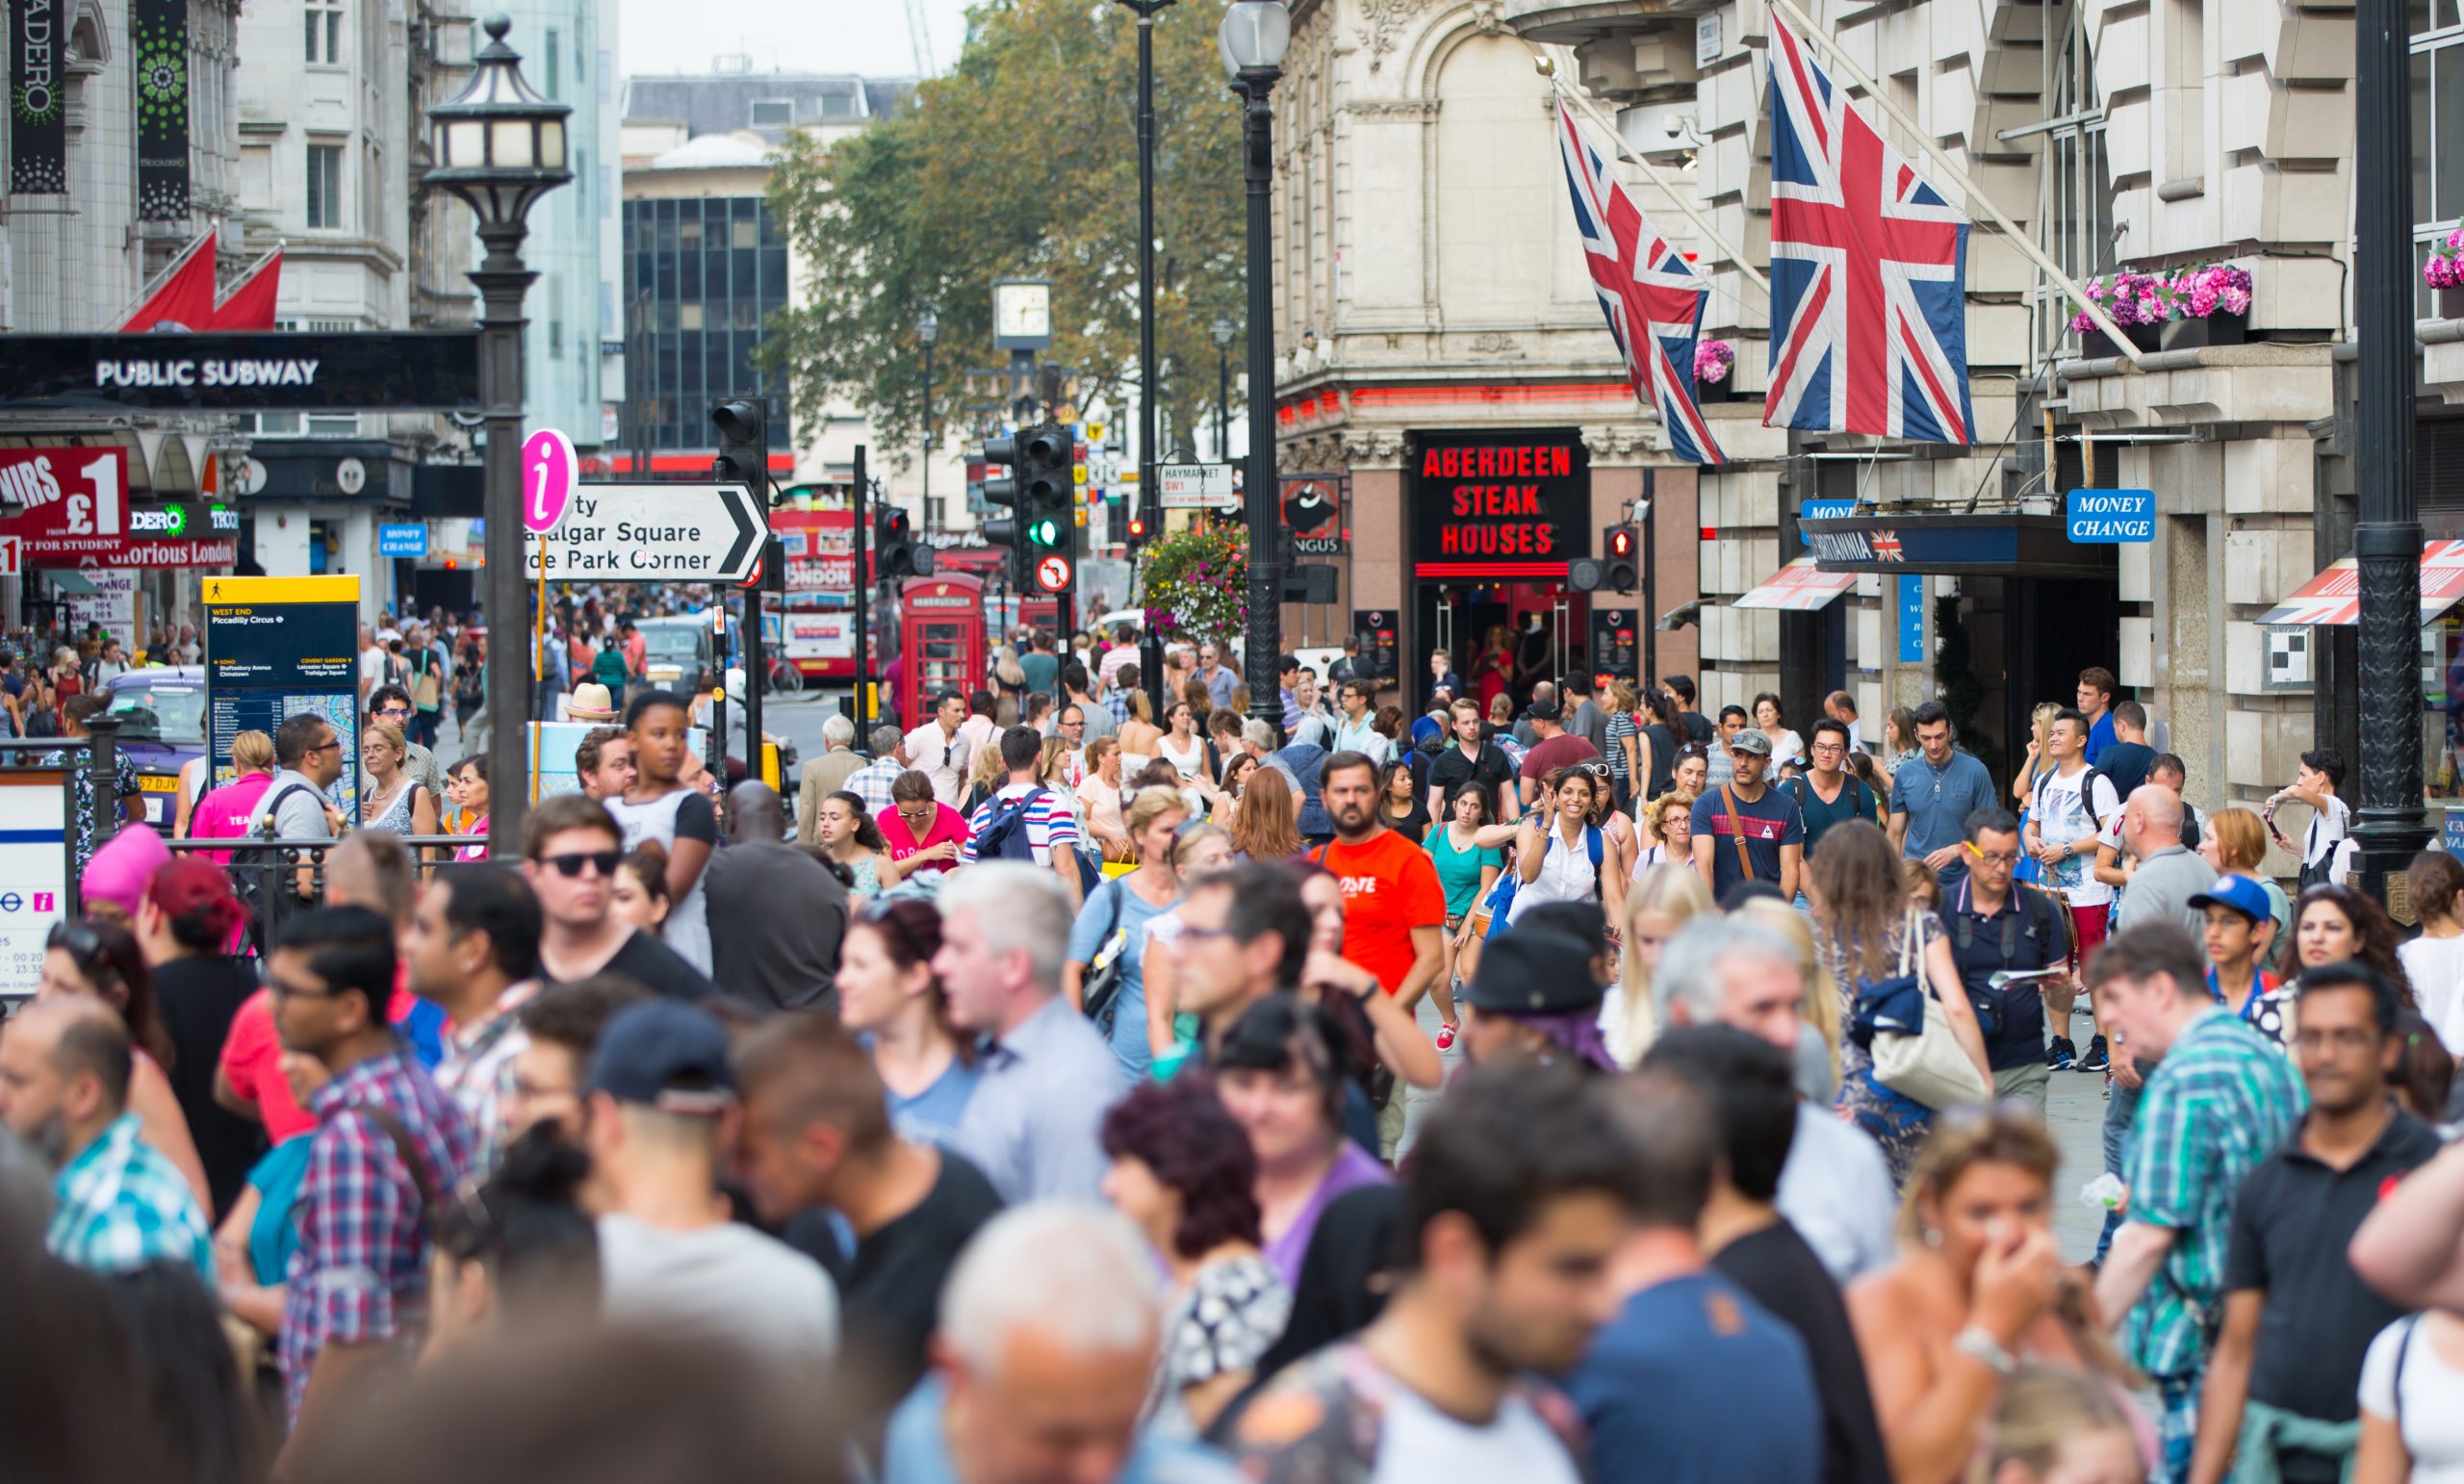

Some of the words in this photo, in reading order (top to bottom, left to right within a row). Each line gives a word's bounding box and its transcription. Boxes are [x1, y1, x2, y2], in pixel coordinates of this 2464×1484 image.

[97, 360, 195, 386] PUBLIC
[202, 360, 320, 386] SUBWAY
[1423, 446, 1571, 477] ABERDEEN
[1165, 469, 1219, 478] HAYMARKET
[1165, 481, 1185, 492] SW1
[572, 495, 598, 518] ty
[1451, 485, 1540, 517] STEAK
[2077, 497, 2146, 513] MONEY
[1810, 506, 1854, 519] MON
[617, 523, 701, 545] Square
[1441, 524, 1553, 554] HOUSES
[2072, 521, 2150, 536] CHANGE
[36, 541, 60, 551] FOR
[63, 540, 121, 550] STUDENT
[192, 540, 232, 564] London
[1813, 531, 1873, 560] BRITANNIA
[568, 550, 619, 569] Park
[630, 550, 711, 570] Corner
[212, 616, 249, 626] Piccadilly
